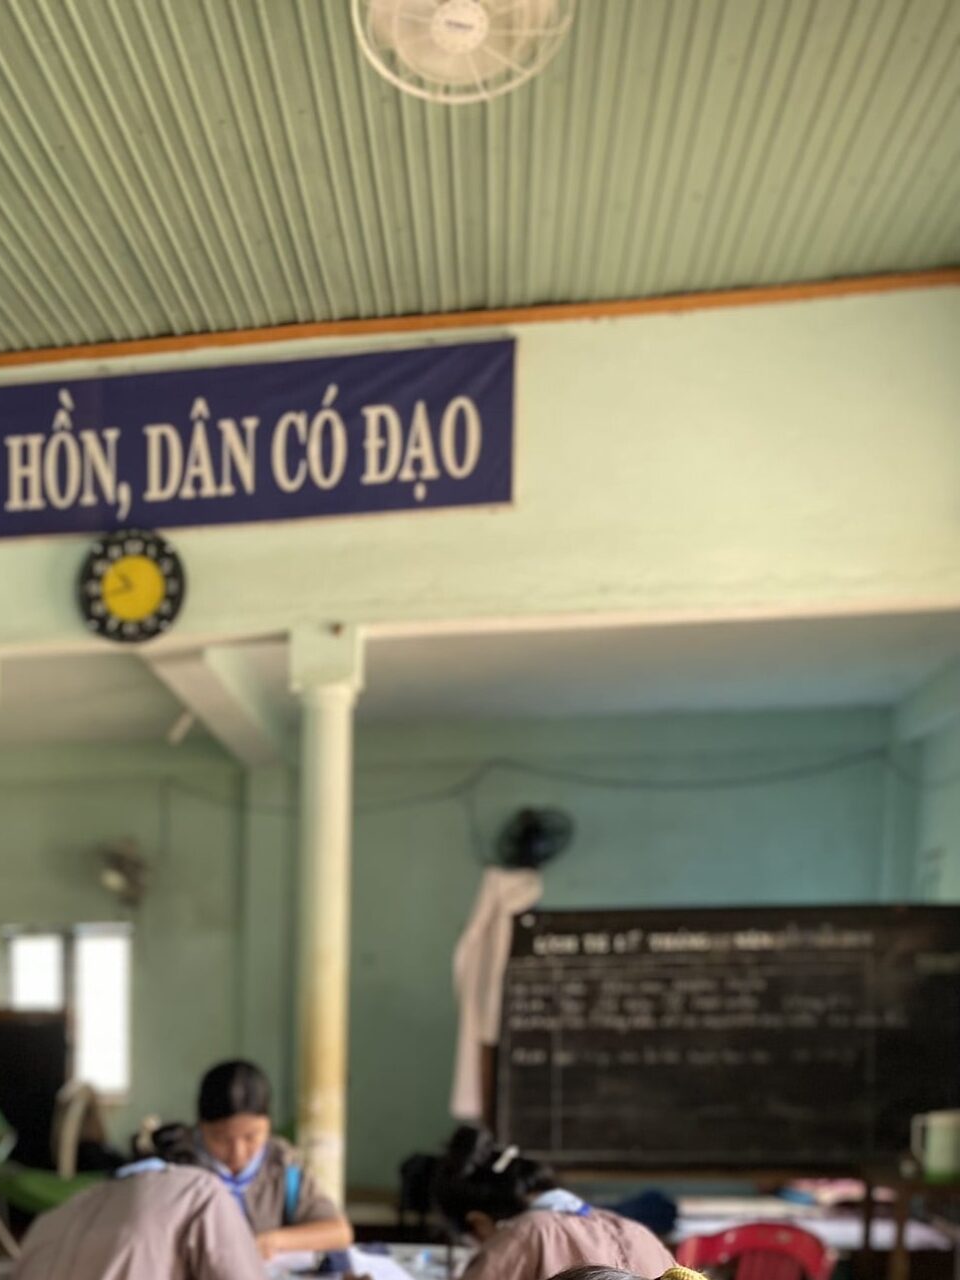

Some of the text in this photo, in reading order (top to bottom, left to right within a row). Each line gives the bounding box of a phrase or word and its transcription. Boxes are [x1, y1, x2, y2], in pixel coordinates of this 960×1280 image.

[3, 389, 131, 522] HỒN,
[143, 398, 259, 501] DÂN
[271, 384, 347, 492] CÓ
[361, 396, 481, 501] ĐẠO
